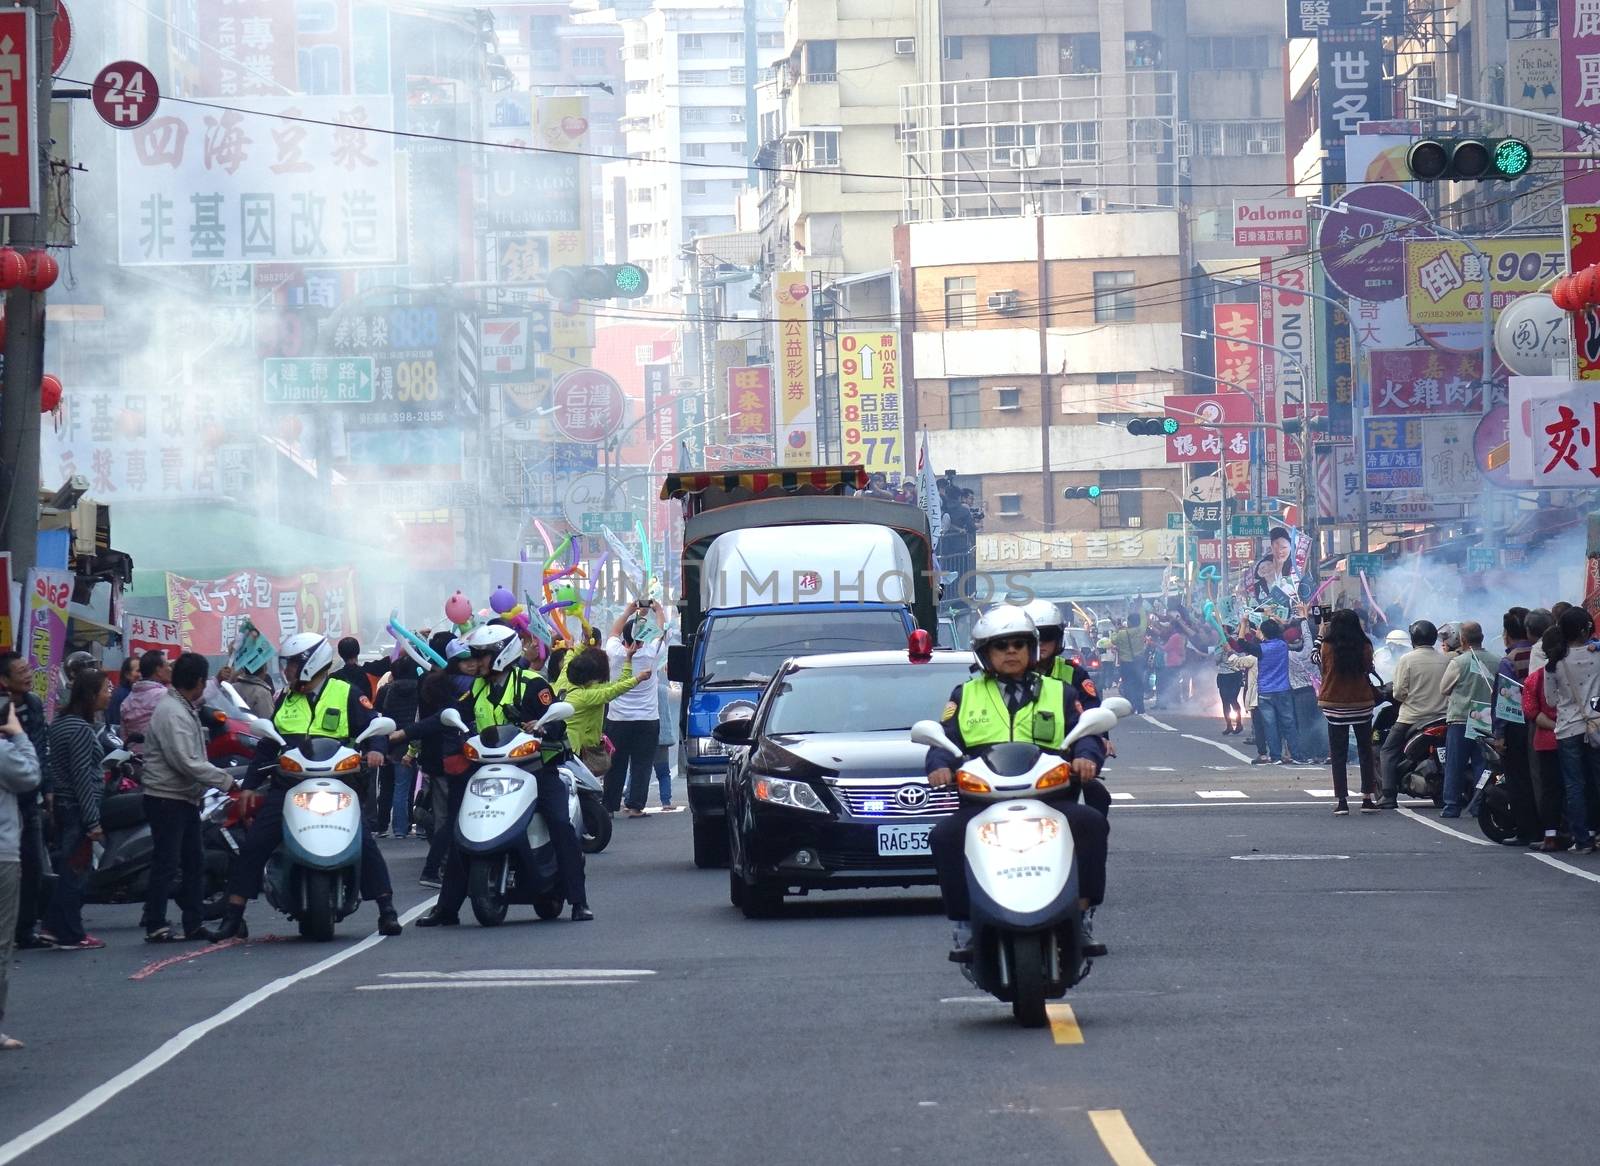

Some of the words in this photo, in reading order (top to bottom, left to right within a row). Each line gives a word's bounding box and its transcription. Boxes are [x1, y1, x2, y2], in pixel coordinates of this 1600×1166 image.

[104, 72, 146, 103] 24
[1331, 51, 1369, 131] 世名
[115, 105, 138, 121] H
[133, 107, 378, 174] 四海豆漿
[138, 192, 377, 258] 非基因改造
[1238, 205, 1303, 221] Paloma
[785, 319, 805, 400] 公益彩券
[338, 383, 360, 399] Rd.
[567, 384, 611, 406] 台灣
